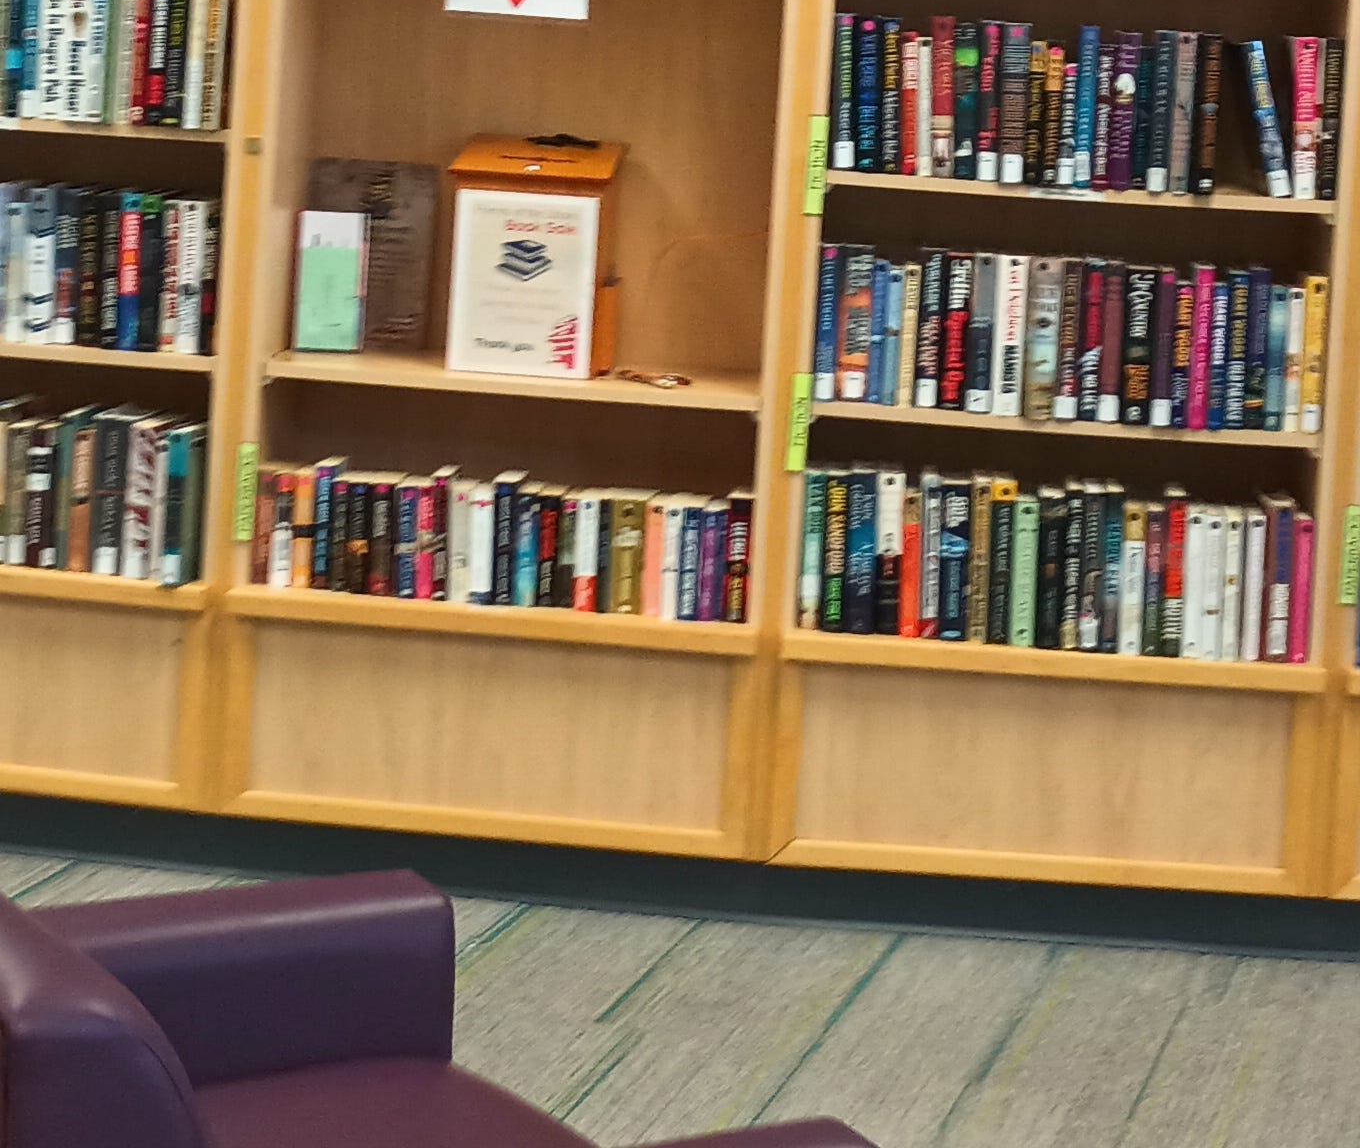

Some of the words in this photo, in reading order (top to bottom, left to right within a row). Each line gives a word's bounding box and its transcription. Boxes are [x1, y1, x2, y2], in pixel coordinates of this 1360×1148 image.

[808, 139, 826, 191] FICTION
[1177, 295, 1191, 327] TUART
[1216, 296, 1227, 326] TUART
[1235, 283, 1246, 316] TUART
[791, 395, 809, 447] FICTION
